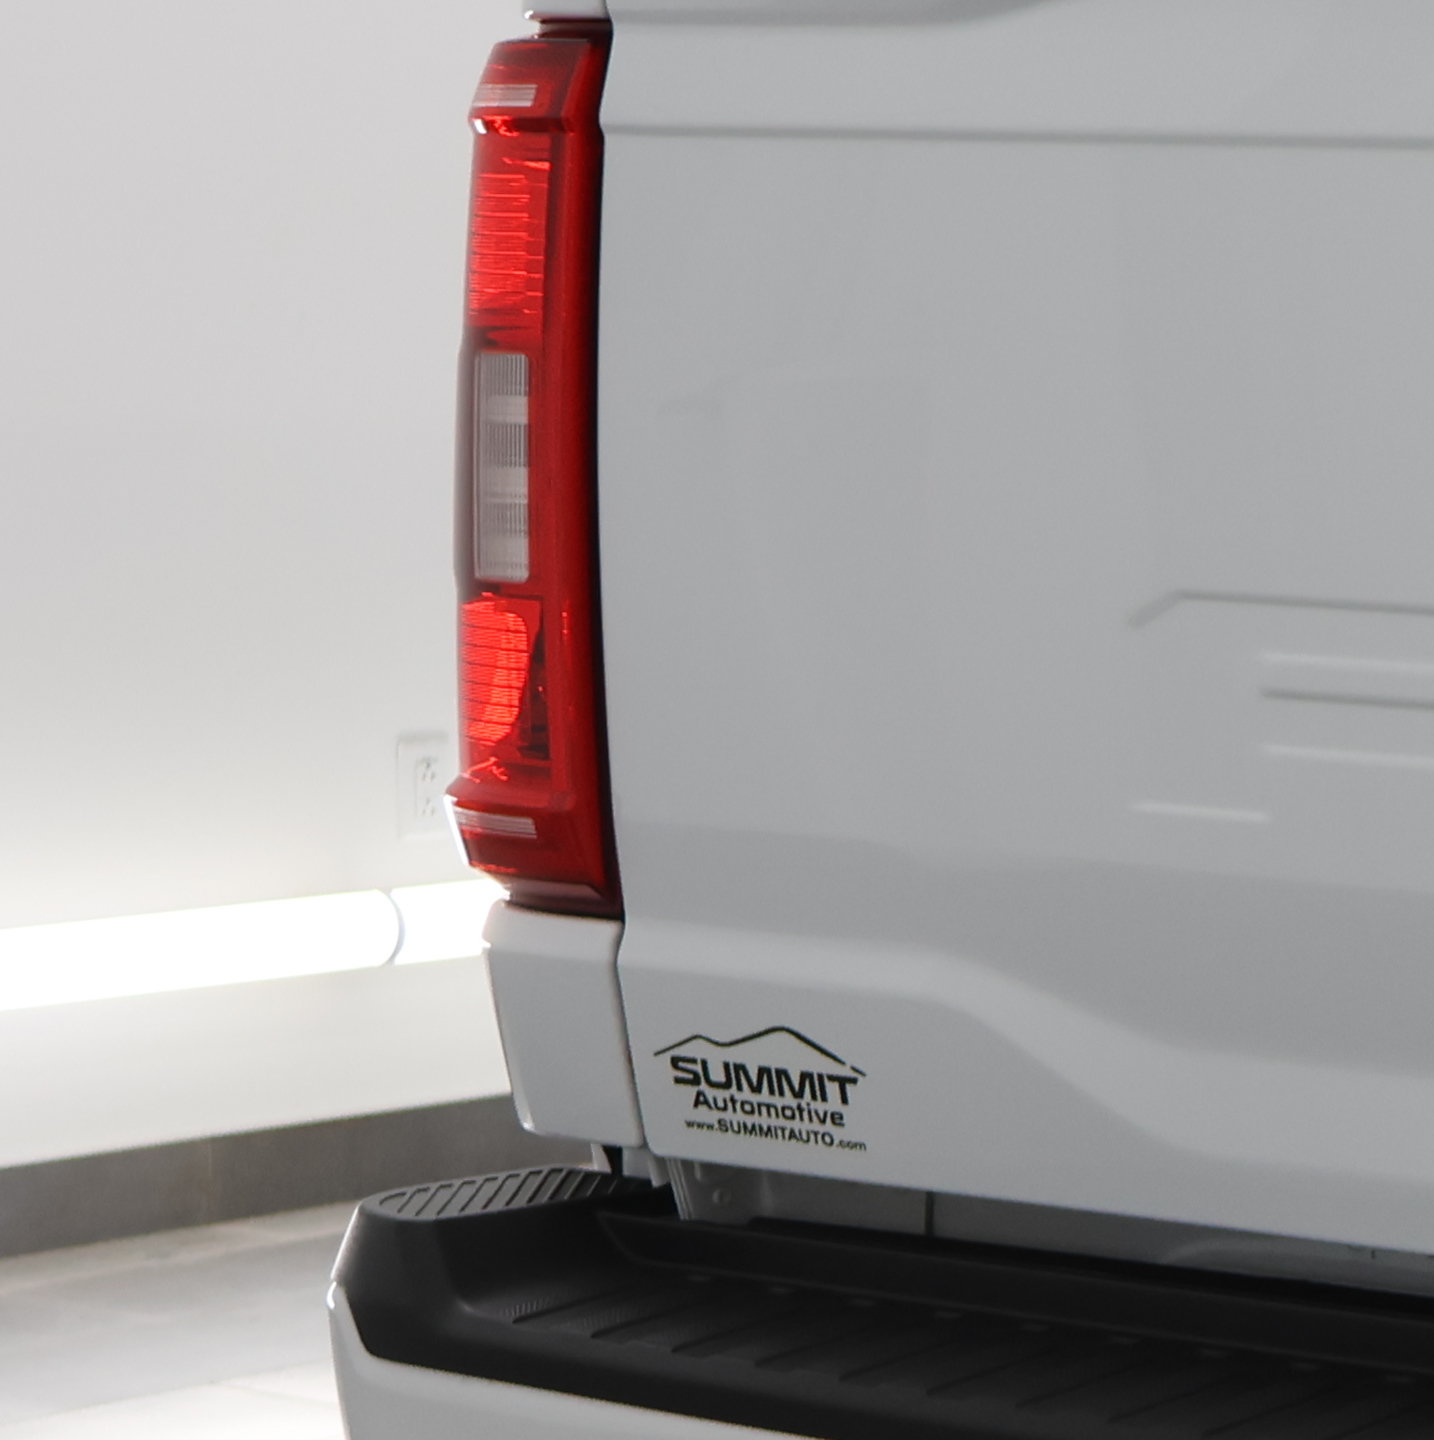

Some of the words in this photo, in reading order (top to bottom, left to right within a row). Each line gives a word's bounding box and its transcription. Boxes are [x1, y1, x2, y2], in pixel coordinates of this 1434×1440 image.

[669, 1054, 859, 1107] SUMMIT
[692, 1088, 847, 1129] Automotive
[684, 1117, 867, 1152] www.SUMMITAUTO.com
